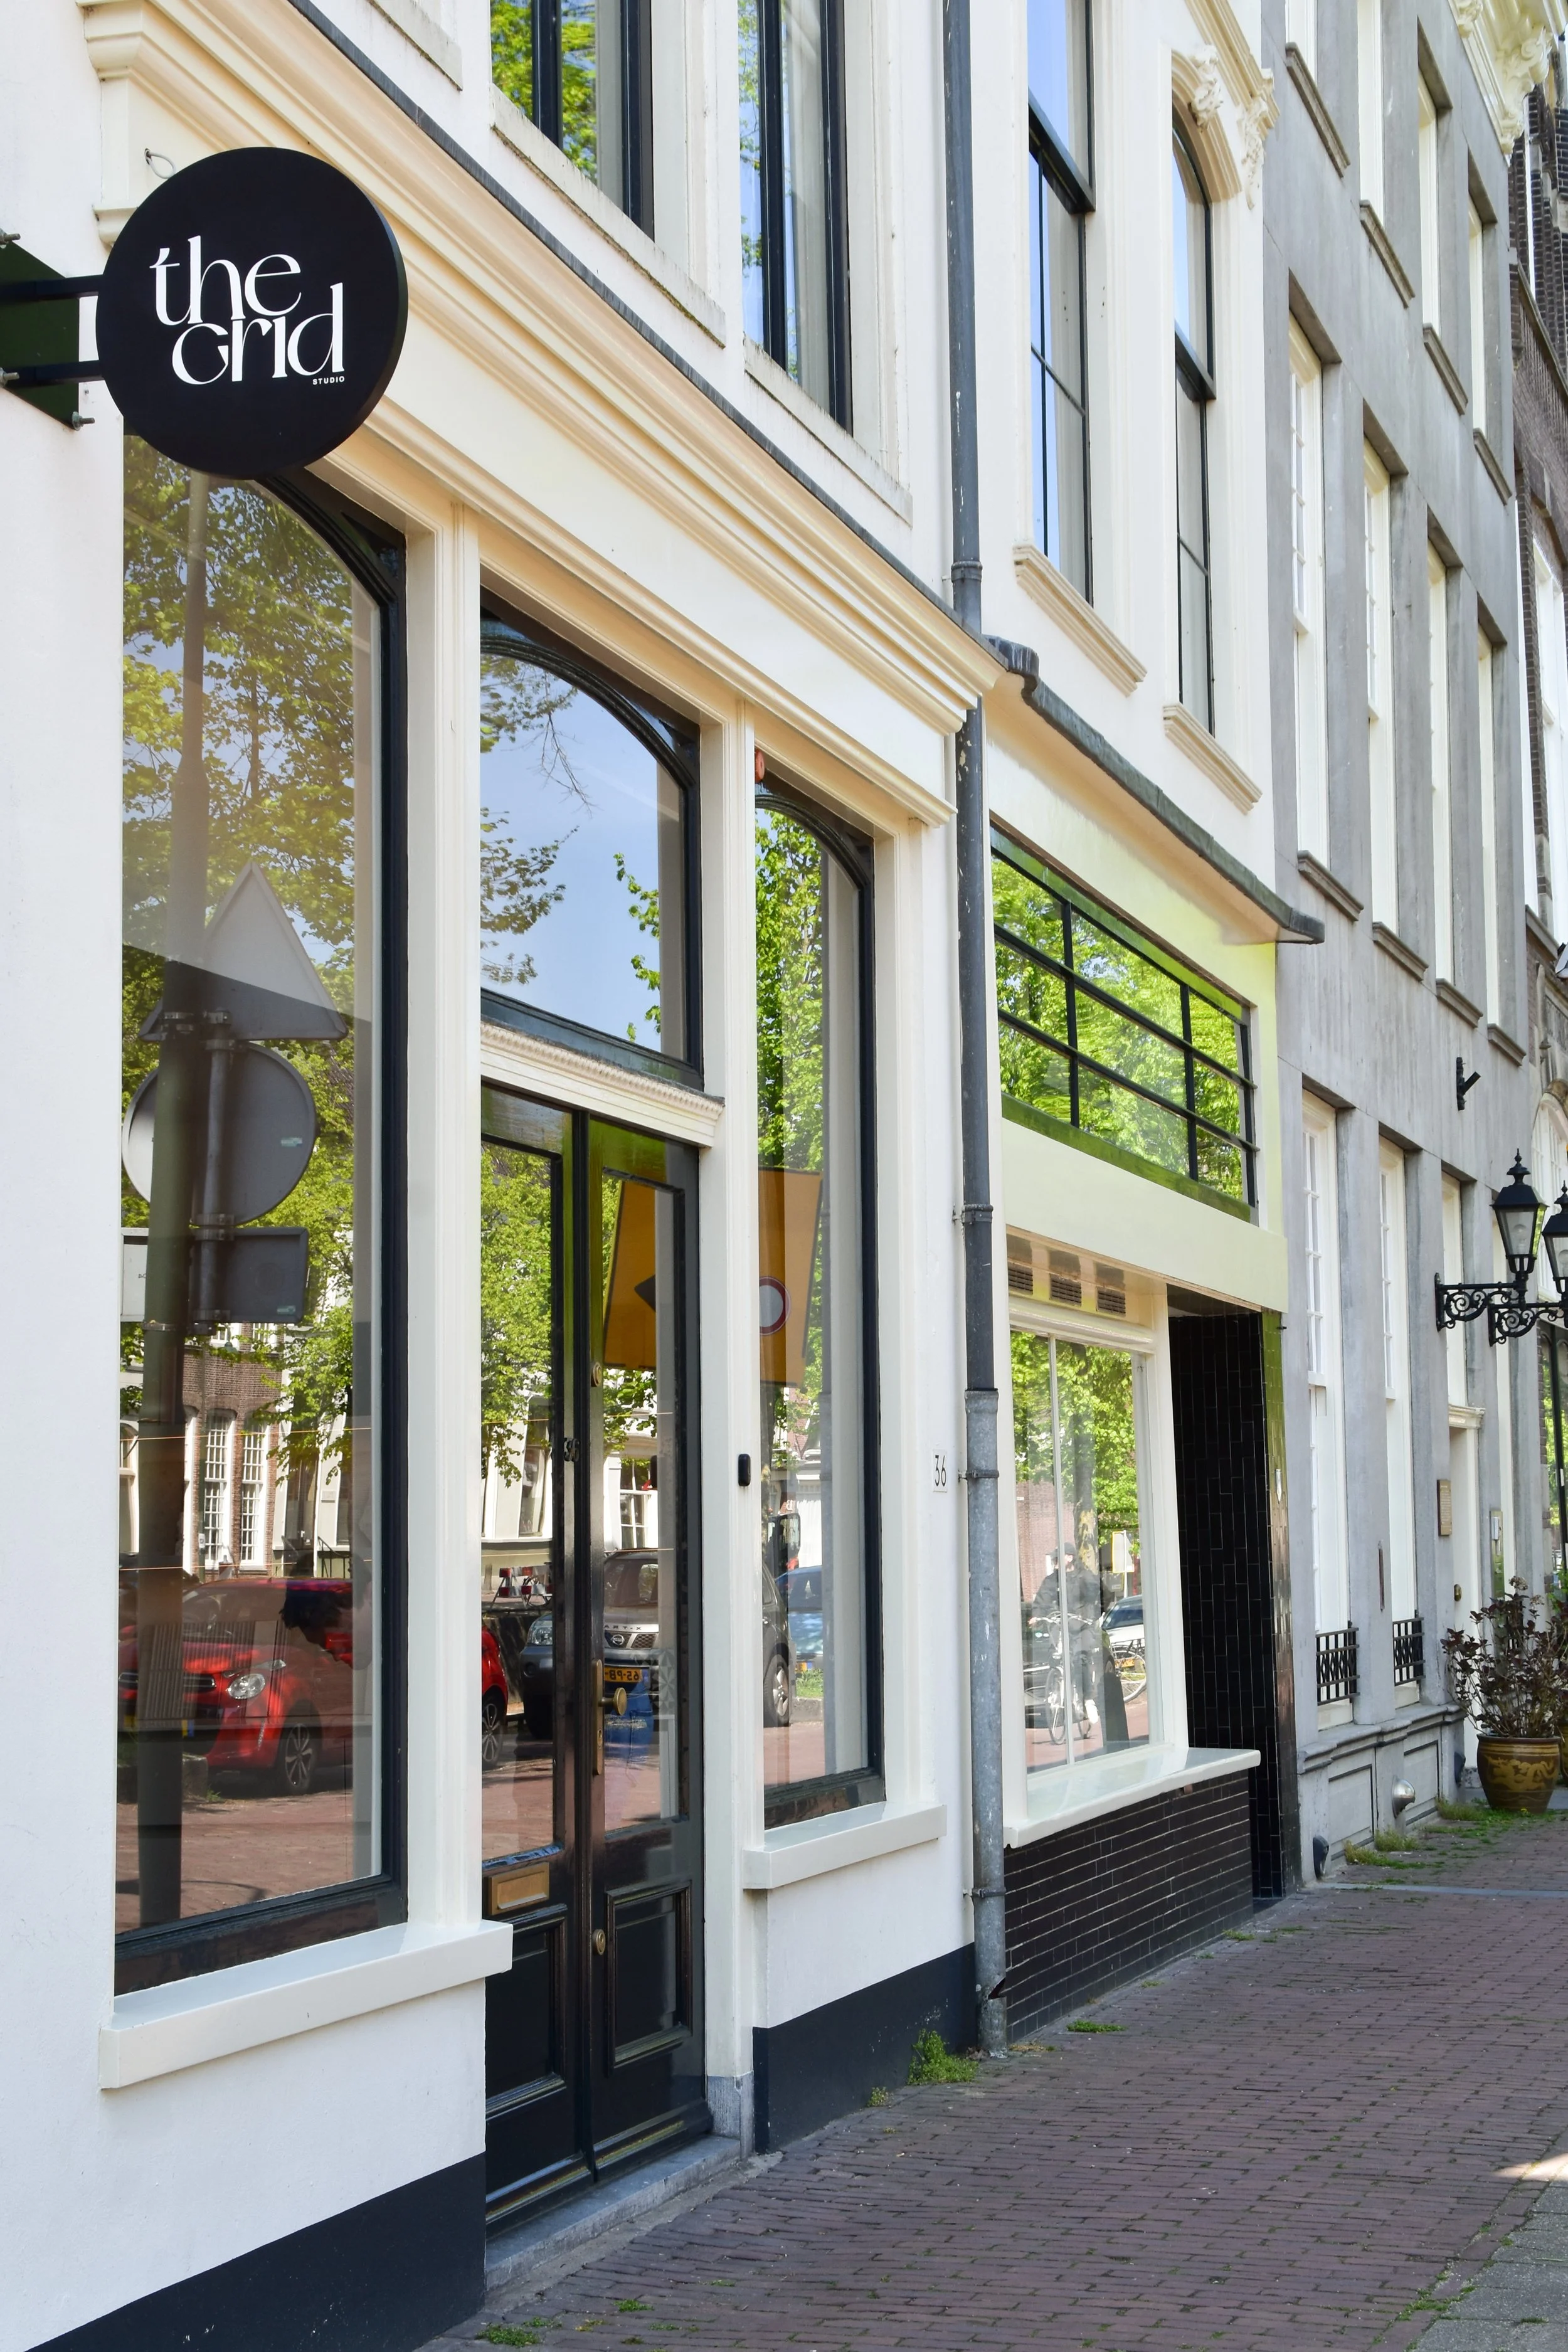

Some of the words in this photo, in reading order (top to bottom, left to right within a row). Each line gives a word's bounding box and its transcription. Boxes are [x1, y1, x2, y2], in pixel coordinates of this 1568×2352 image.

[150, 235, 302, 326] the
[312, 376, 345, 385] STUDIO
[935, 1454, 946, 1486] 36
